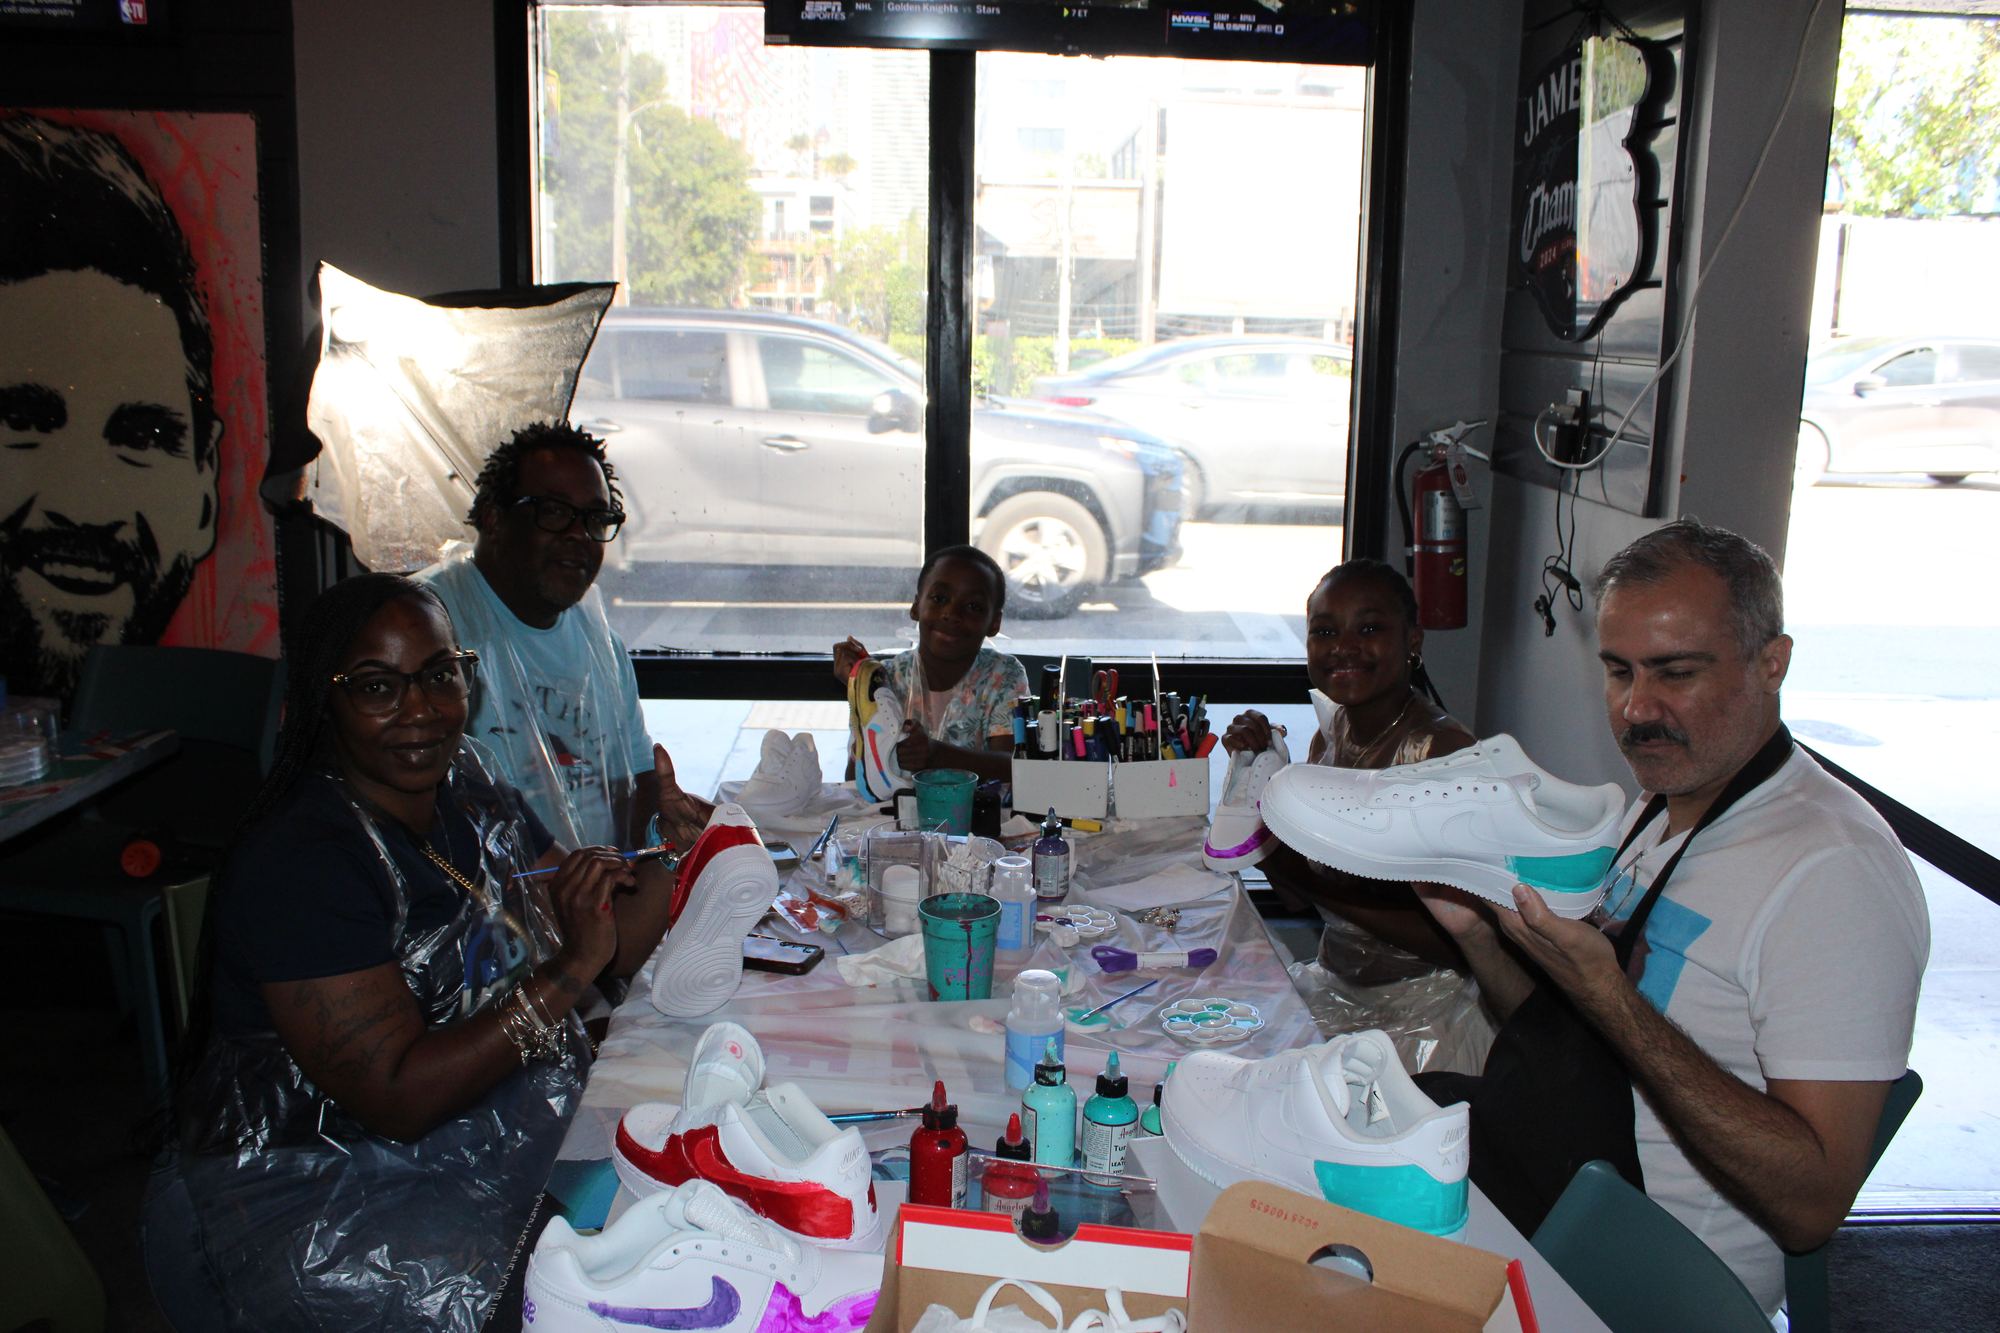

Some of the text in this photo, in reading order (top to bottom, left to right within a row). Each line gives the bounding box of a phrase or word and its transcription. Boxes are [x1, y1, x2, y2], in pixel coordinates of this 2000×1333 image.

[804, 1, 842, 11] ESPN
[855, 2, 872, 11] NHL
[887, 2, 922, 12] Golden
[923, 4, 959, 14] Knights
[976, 4, 1001, 15] Stars
[801, 11, 846, 20] DEPORTES
[1171, 14, 1210, 24] NWSL
